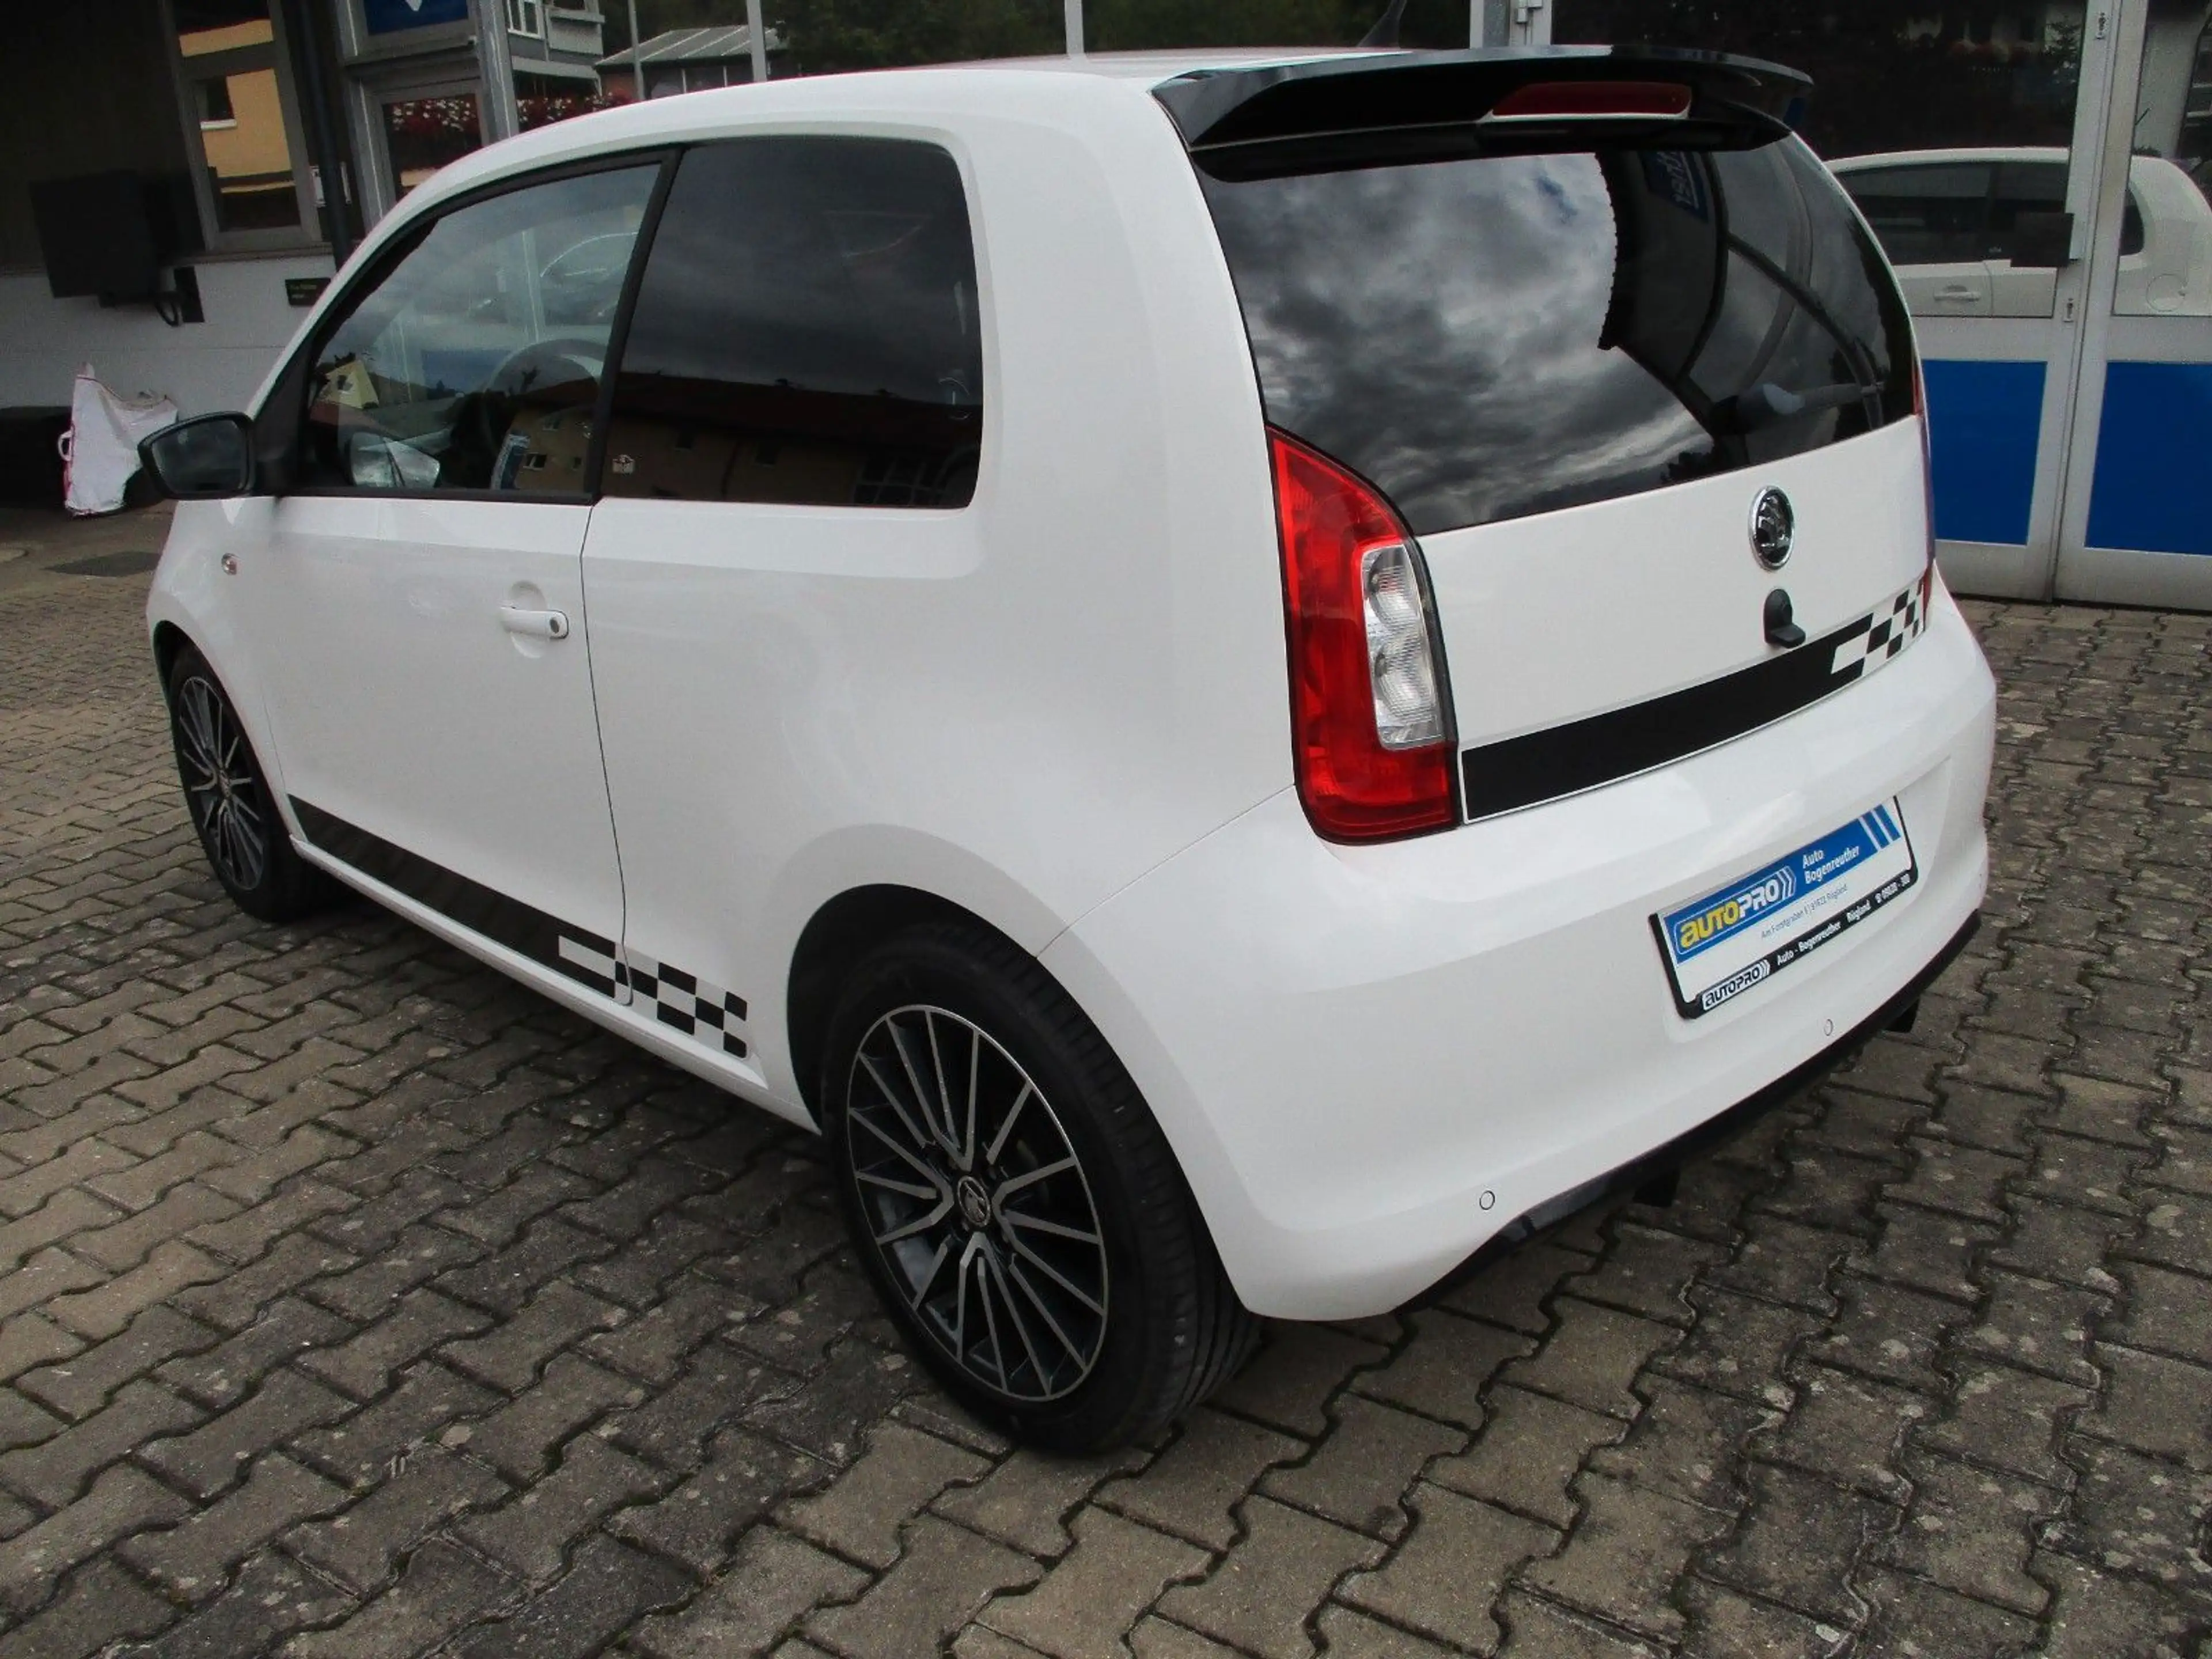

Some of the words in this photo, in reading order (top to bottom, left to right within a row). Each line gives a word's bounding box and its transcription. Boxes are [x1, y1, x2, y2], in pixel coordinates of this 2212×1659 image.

[1802, 850, 1824, 869] Auto
[1805, 846, 1859, 884] Bogenreuther
[1777, 949, 1794, 965] Auto
